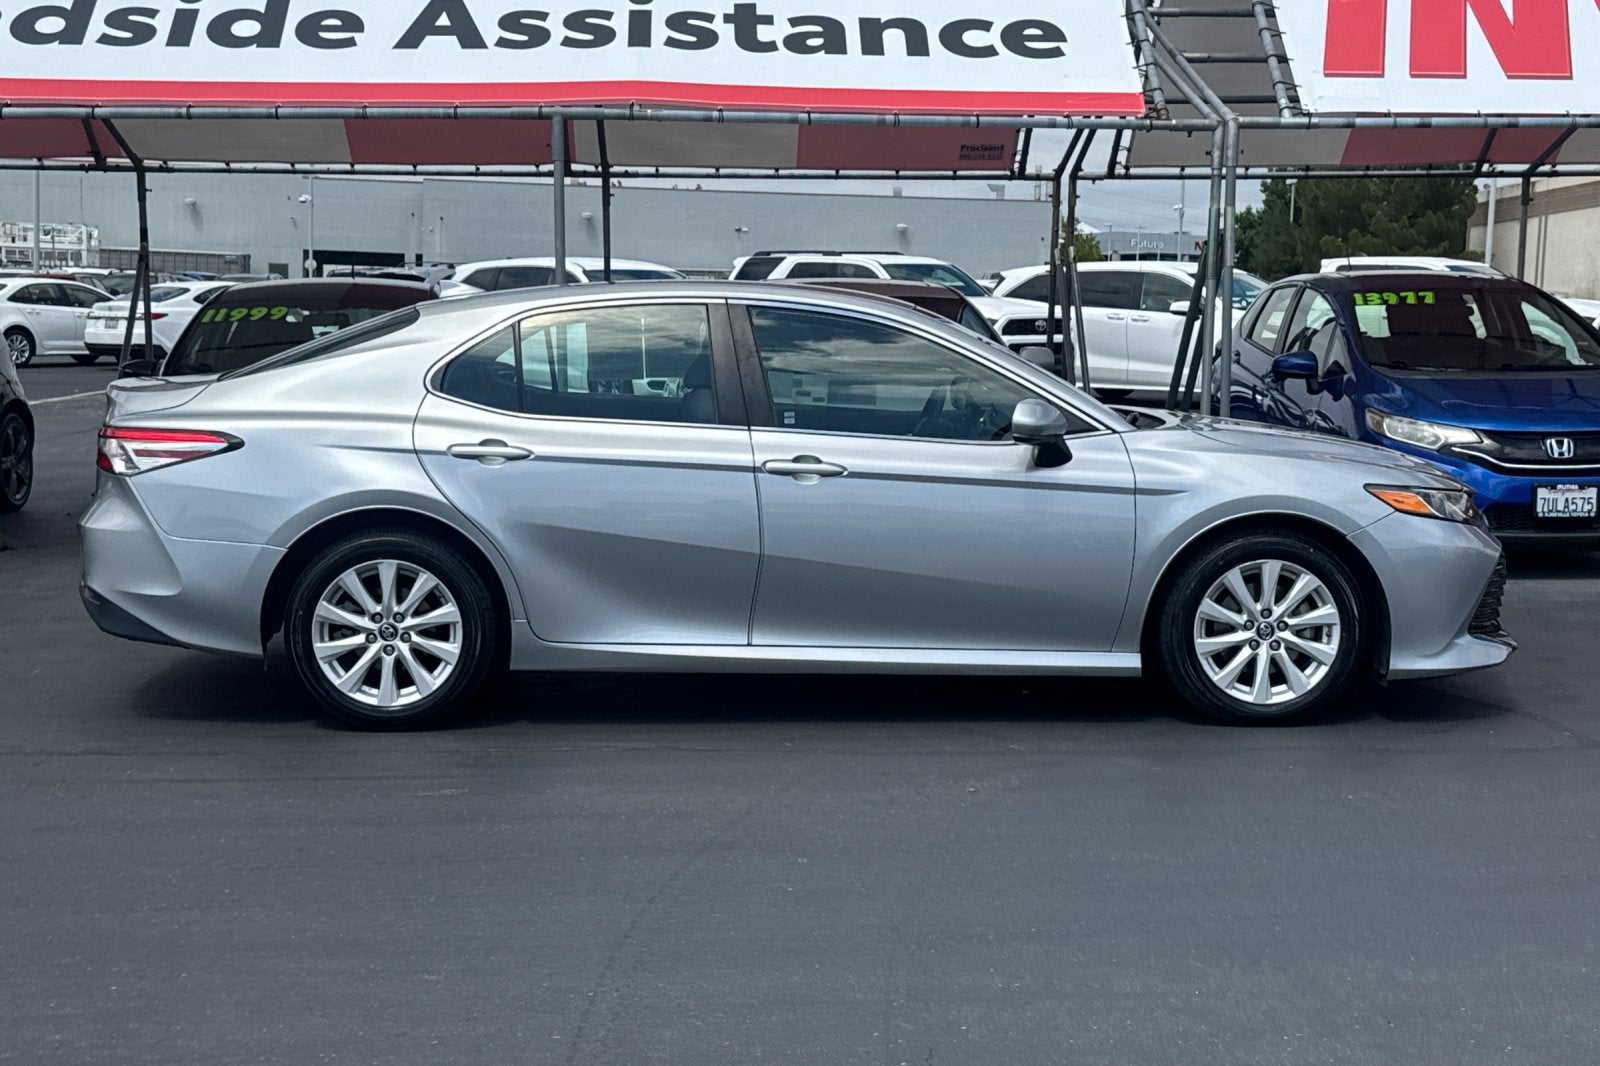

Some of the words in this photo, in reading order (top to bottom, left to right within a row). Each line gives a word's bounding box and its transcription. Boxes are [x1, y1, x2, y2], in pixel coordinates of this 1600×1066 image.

[0, 0, 365, 49] dside
[392, 0, 1068, 59] Assistance
[1323, 0, 1600, 80] IN
[1353, 291, 1436, 305] 13977
[201, 306, 289, 322] 11999
[1539, 496, 1594, 513] 7ULA575
